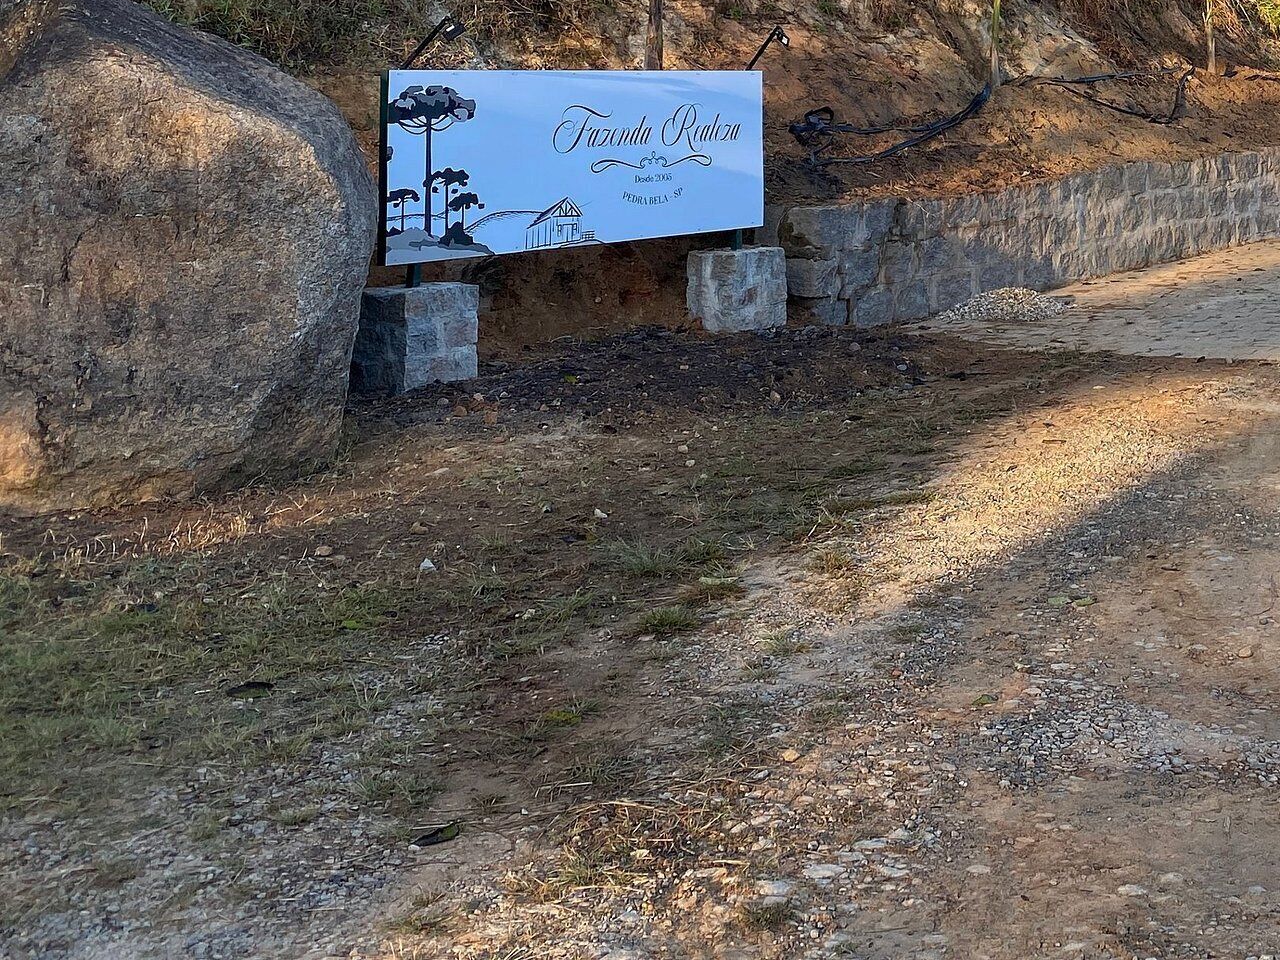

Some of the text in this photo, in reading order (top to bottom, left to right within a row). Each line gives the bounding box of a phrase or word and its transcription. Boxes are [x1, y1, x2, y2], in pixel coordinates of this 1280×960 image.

[552, 103, 743, 154] Fazenda Realeza
[634, 174, 654, 184] Desde
[622, 191, 648, 205] PEDRA
[649, 194, 669, 205] BELA
[673, 186, 683, 198] SP
